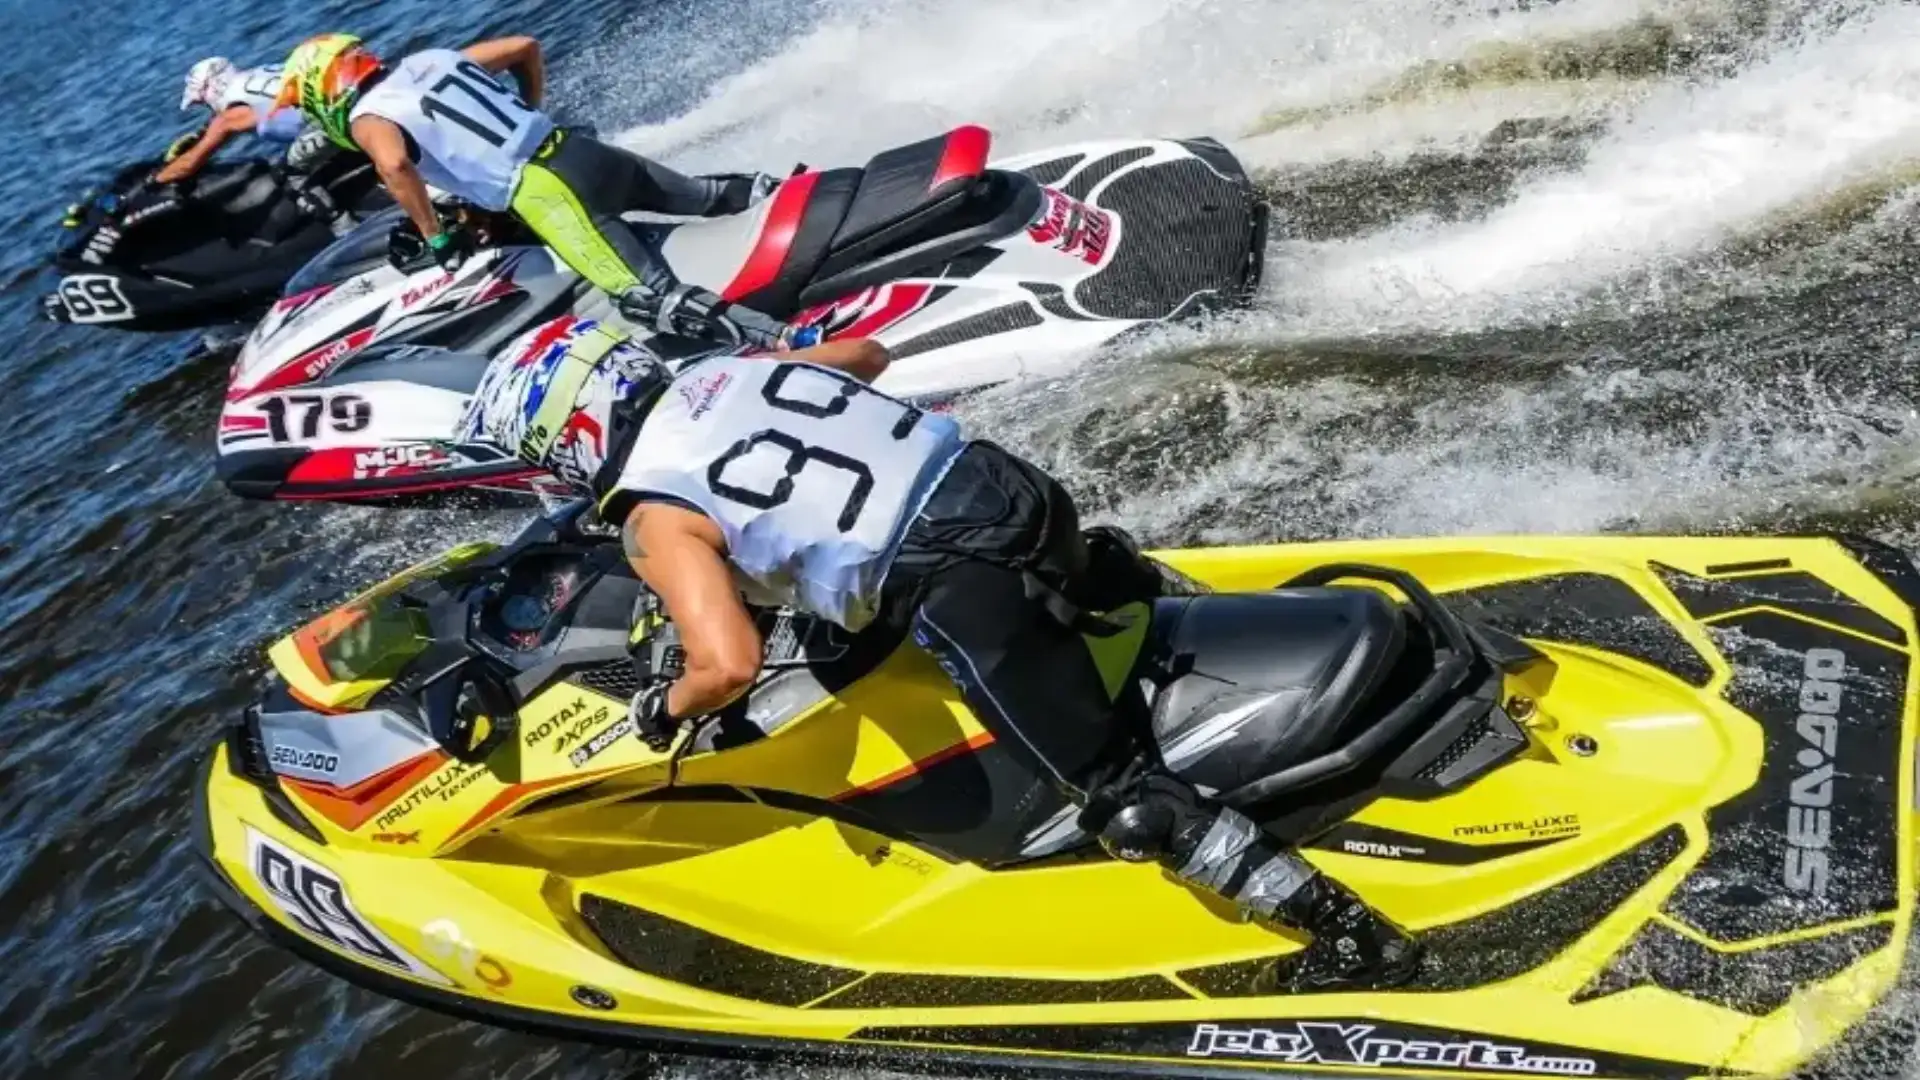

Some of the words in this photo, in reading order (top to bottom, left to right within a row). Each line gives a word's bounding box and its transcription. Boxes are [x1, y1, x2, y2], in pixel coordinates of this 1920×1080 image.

[420, 60, 537, 146] 179
[63, 278, 130, 318] 69
[257, 395, 372, 442] 179
[524, 697, 587, 747] ROTAX
[438, 768, 489, 801] Team
[1344, 840, 1401, 857] ROTAX
[257, 842, 414, 973] 99
[1187, 1022, 1597, 1074] jetsXparts.com
